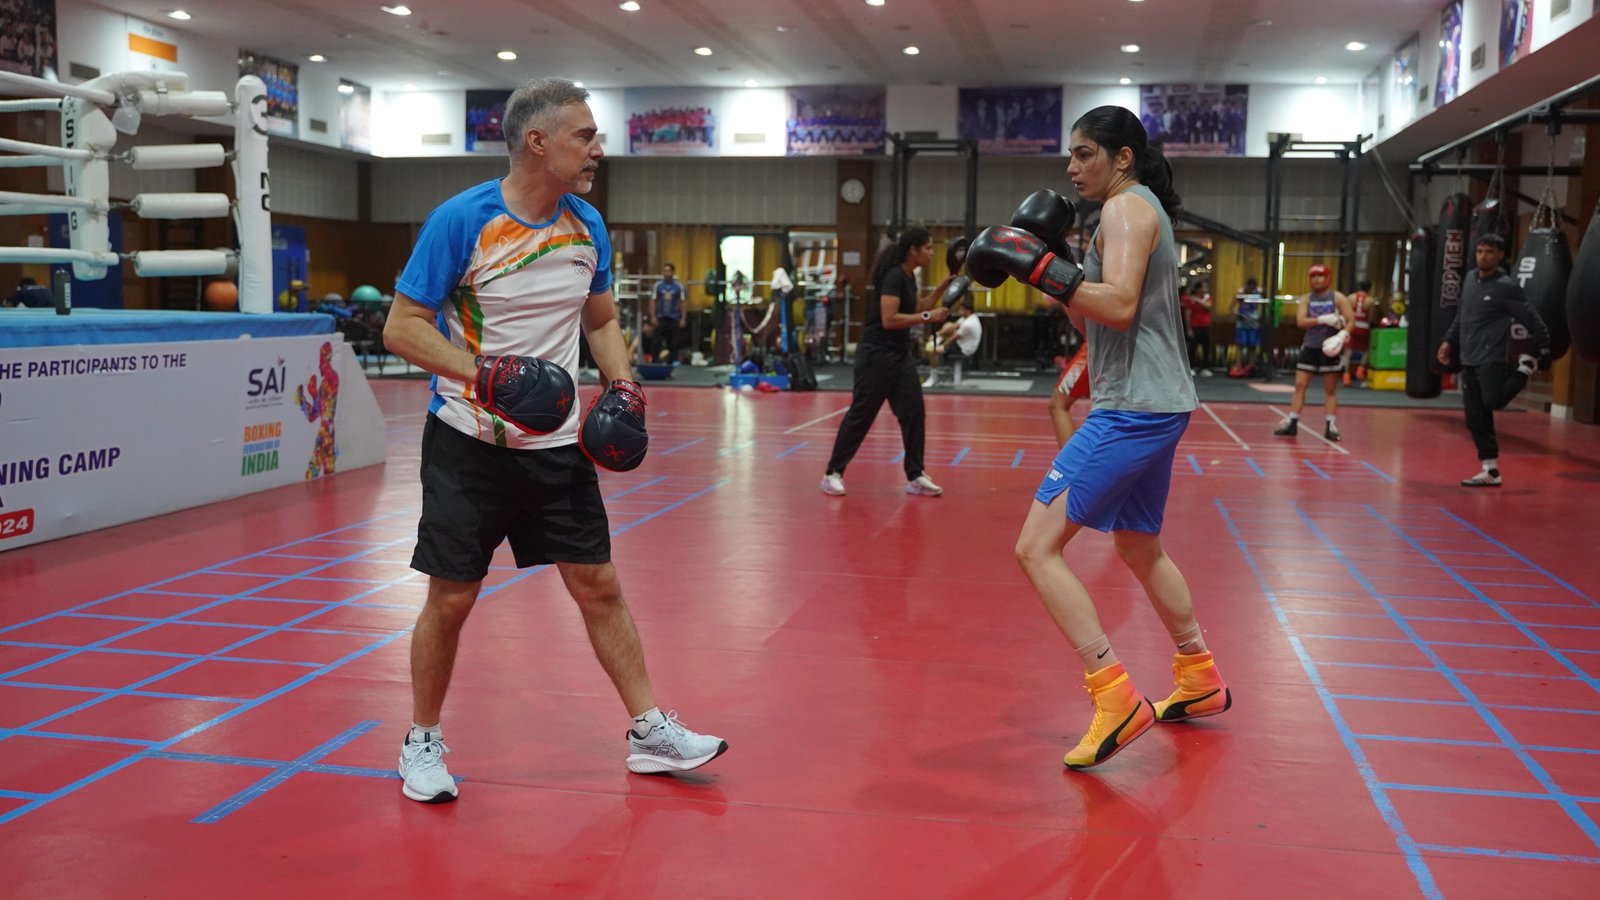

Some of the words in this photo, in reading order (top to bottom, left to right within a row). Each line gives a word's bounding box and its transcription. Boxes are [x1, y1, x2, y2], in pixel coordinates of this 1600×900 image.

[28, 356, 137, 378] PARTICIPANTS
[141, 355, 159, 370] TO
[163, 353, 187, 369] THE
[247, 366, 286, 397] SAI
[243, 421, 281, 443] BOXING
[59, 447, 121, 475] CAMP
[241, 450, 279, 476] INDIA
[0, 516, 29, 535] 24
